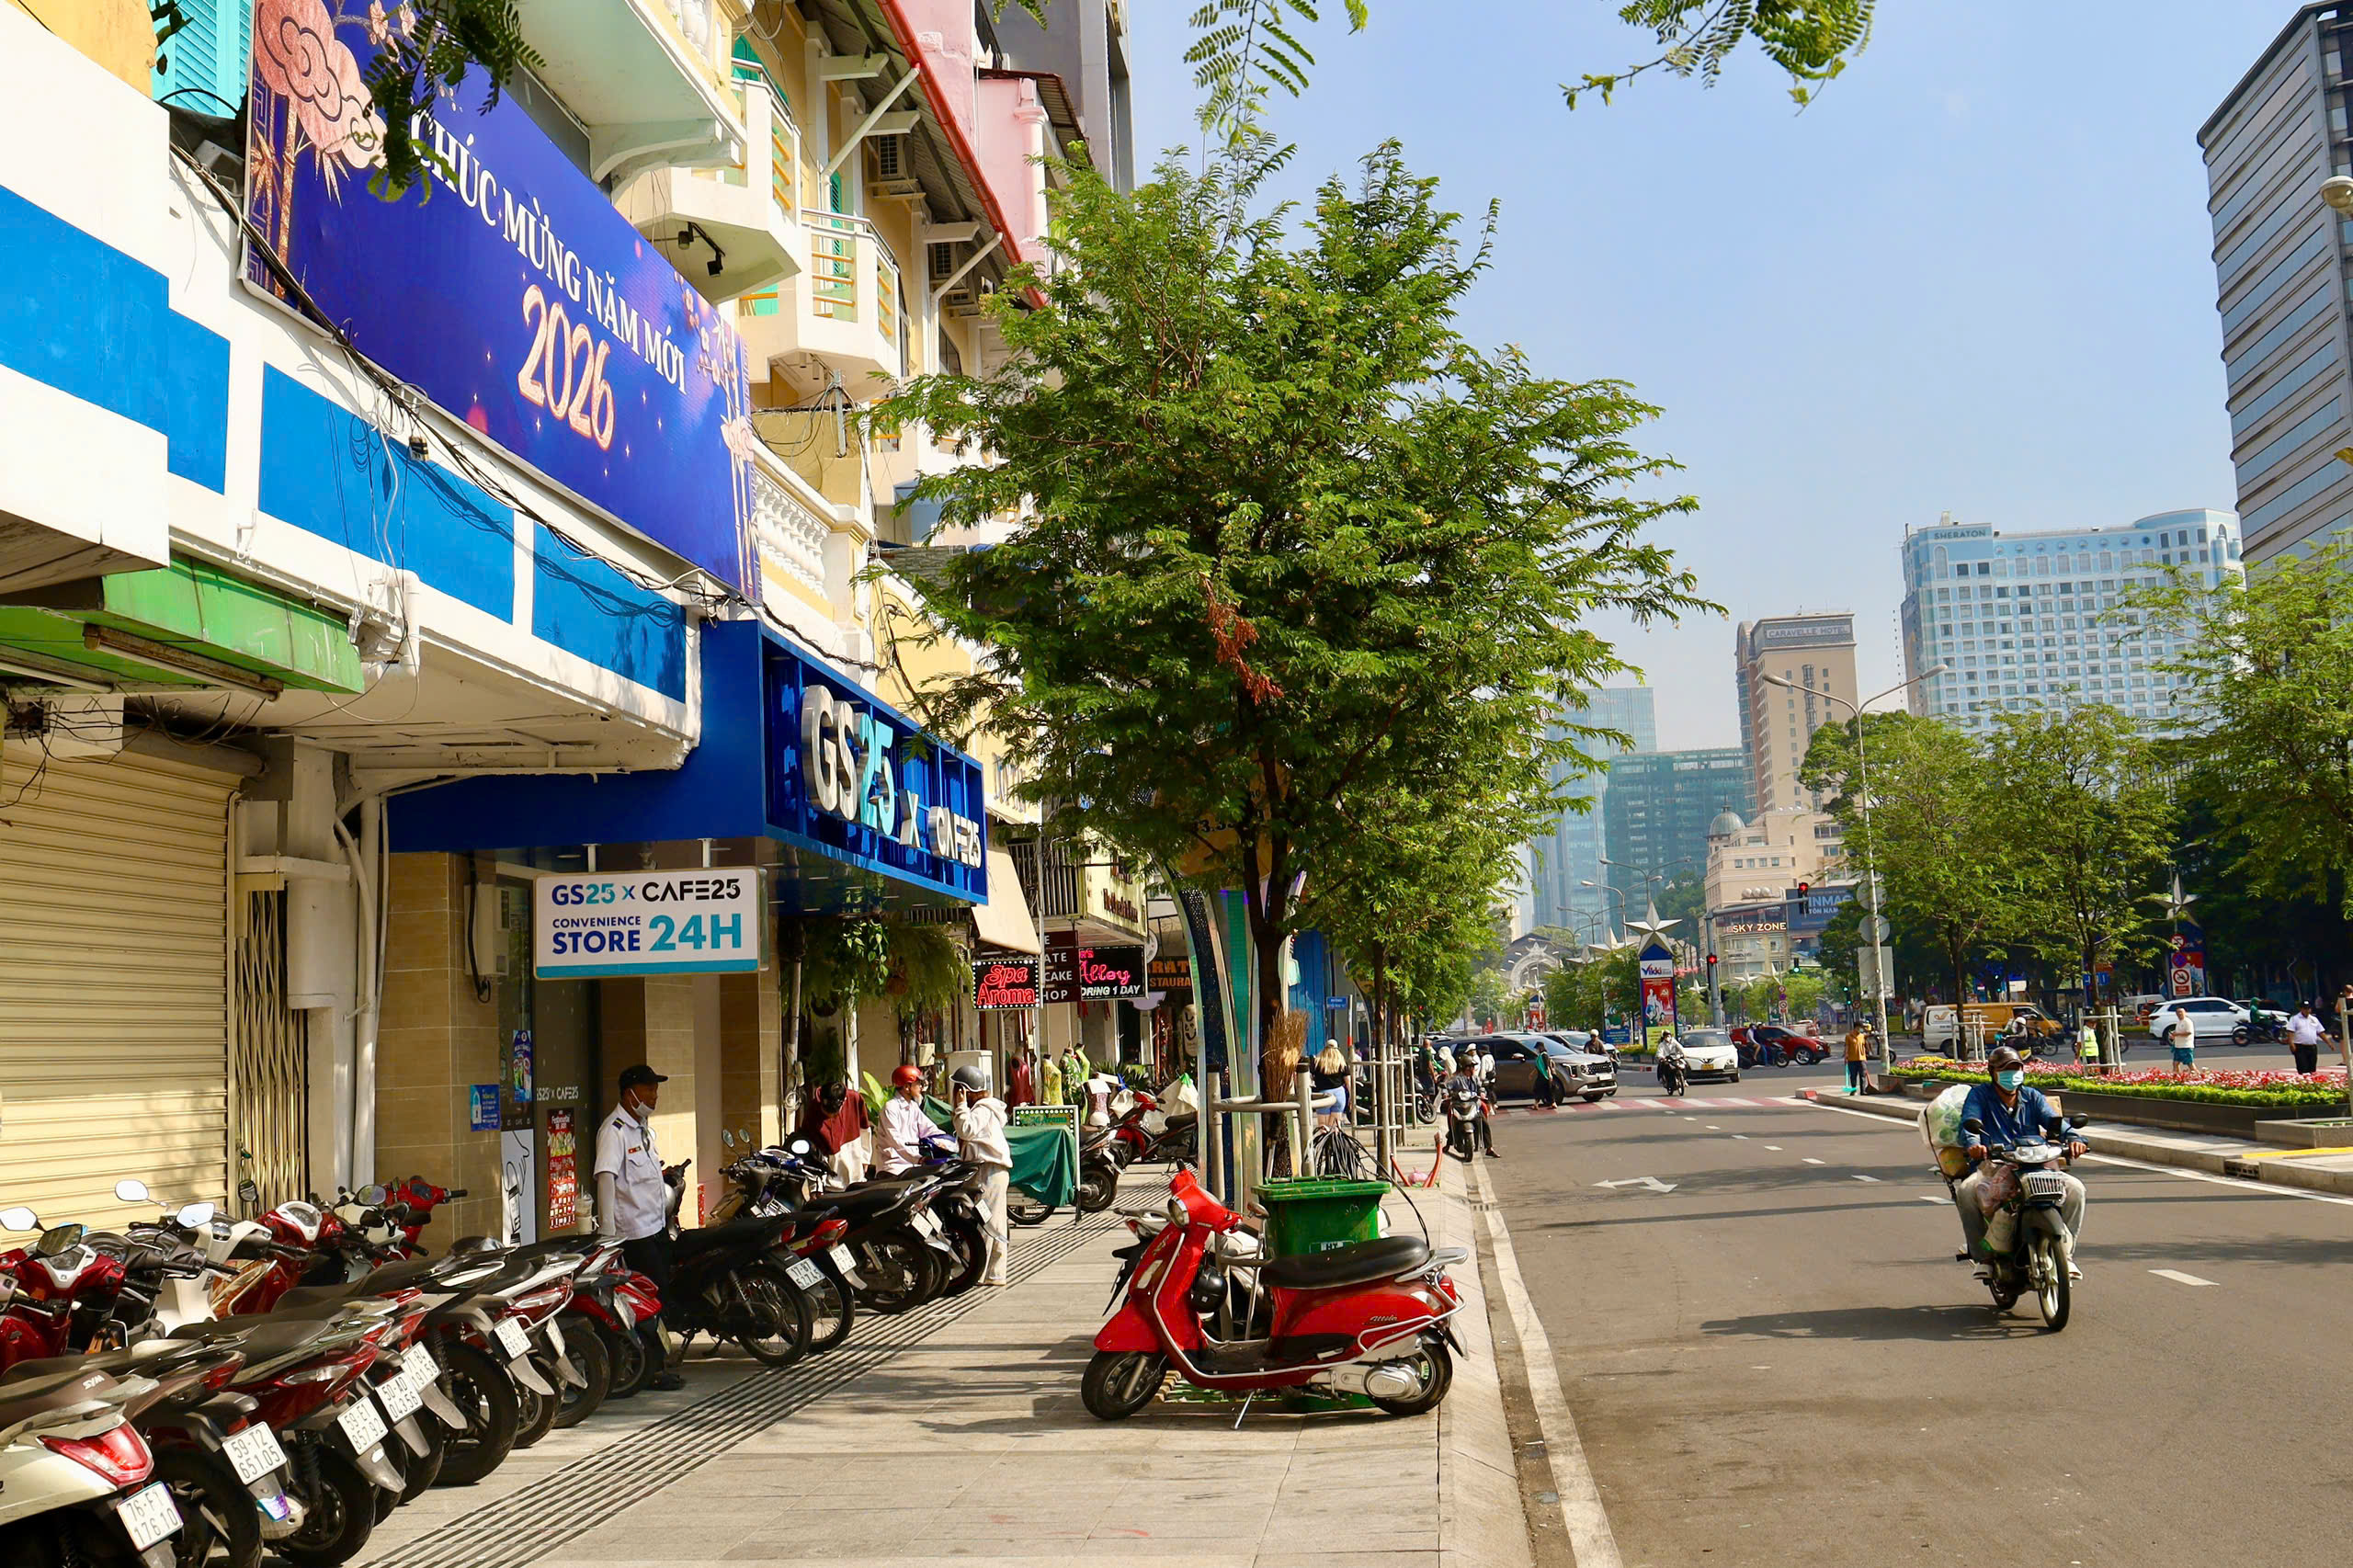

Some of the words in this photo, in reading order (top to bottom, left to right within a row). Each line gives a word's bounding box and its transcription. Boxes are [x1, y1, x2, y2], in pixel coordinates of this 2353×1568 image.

[411, 108, 497, 227] CHÚC
[502, 187, 582, 302] MỪNG
[585, 265, 641, 357] NĂM
[642, 318, 688, 395] MỚI
[517, 283, 614, 450] 2026
[1933, 529, 1986, 540] SHERATON
[1768, 627, 1817, 638] CARAVELLE
[1820, 624, 1848, 634] HOTEL
[801, 684, 895, 836] GS25
[927, 805, 982, 869] CAFE25
[551, 882, 616, 906] GS25
[642, 878, 741, 903] CAFE25
[551, 915, 642, 929] CONVENIENCE
[1733, 923, 1754, 933] SKY
[1756, 922, 1787, 931] ZONE
[551, 929, 641, 955] STORE
[648, 913, 742, 952] 24H
[1044, 952, 1067, 963] ATE
[1152, 960, 1189, 974] RAT
[983, 964, 1029, 989] Spa
[1149, 977, 1192, 987] STAURA
[976, 983, 1036, 1006] Aroma
[1043, 989, 1068, 1001] HOP
[1112, 985, 1119, 995] 1
[1120, 984, 1142, 995] DAY
[82, 1374, 106, 1390] SYM
[230, 1428, 268, 1460] 59-T2
[238, 1445, 281, 1479] 651.05
